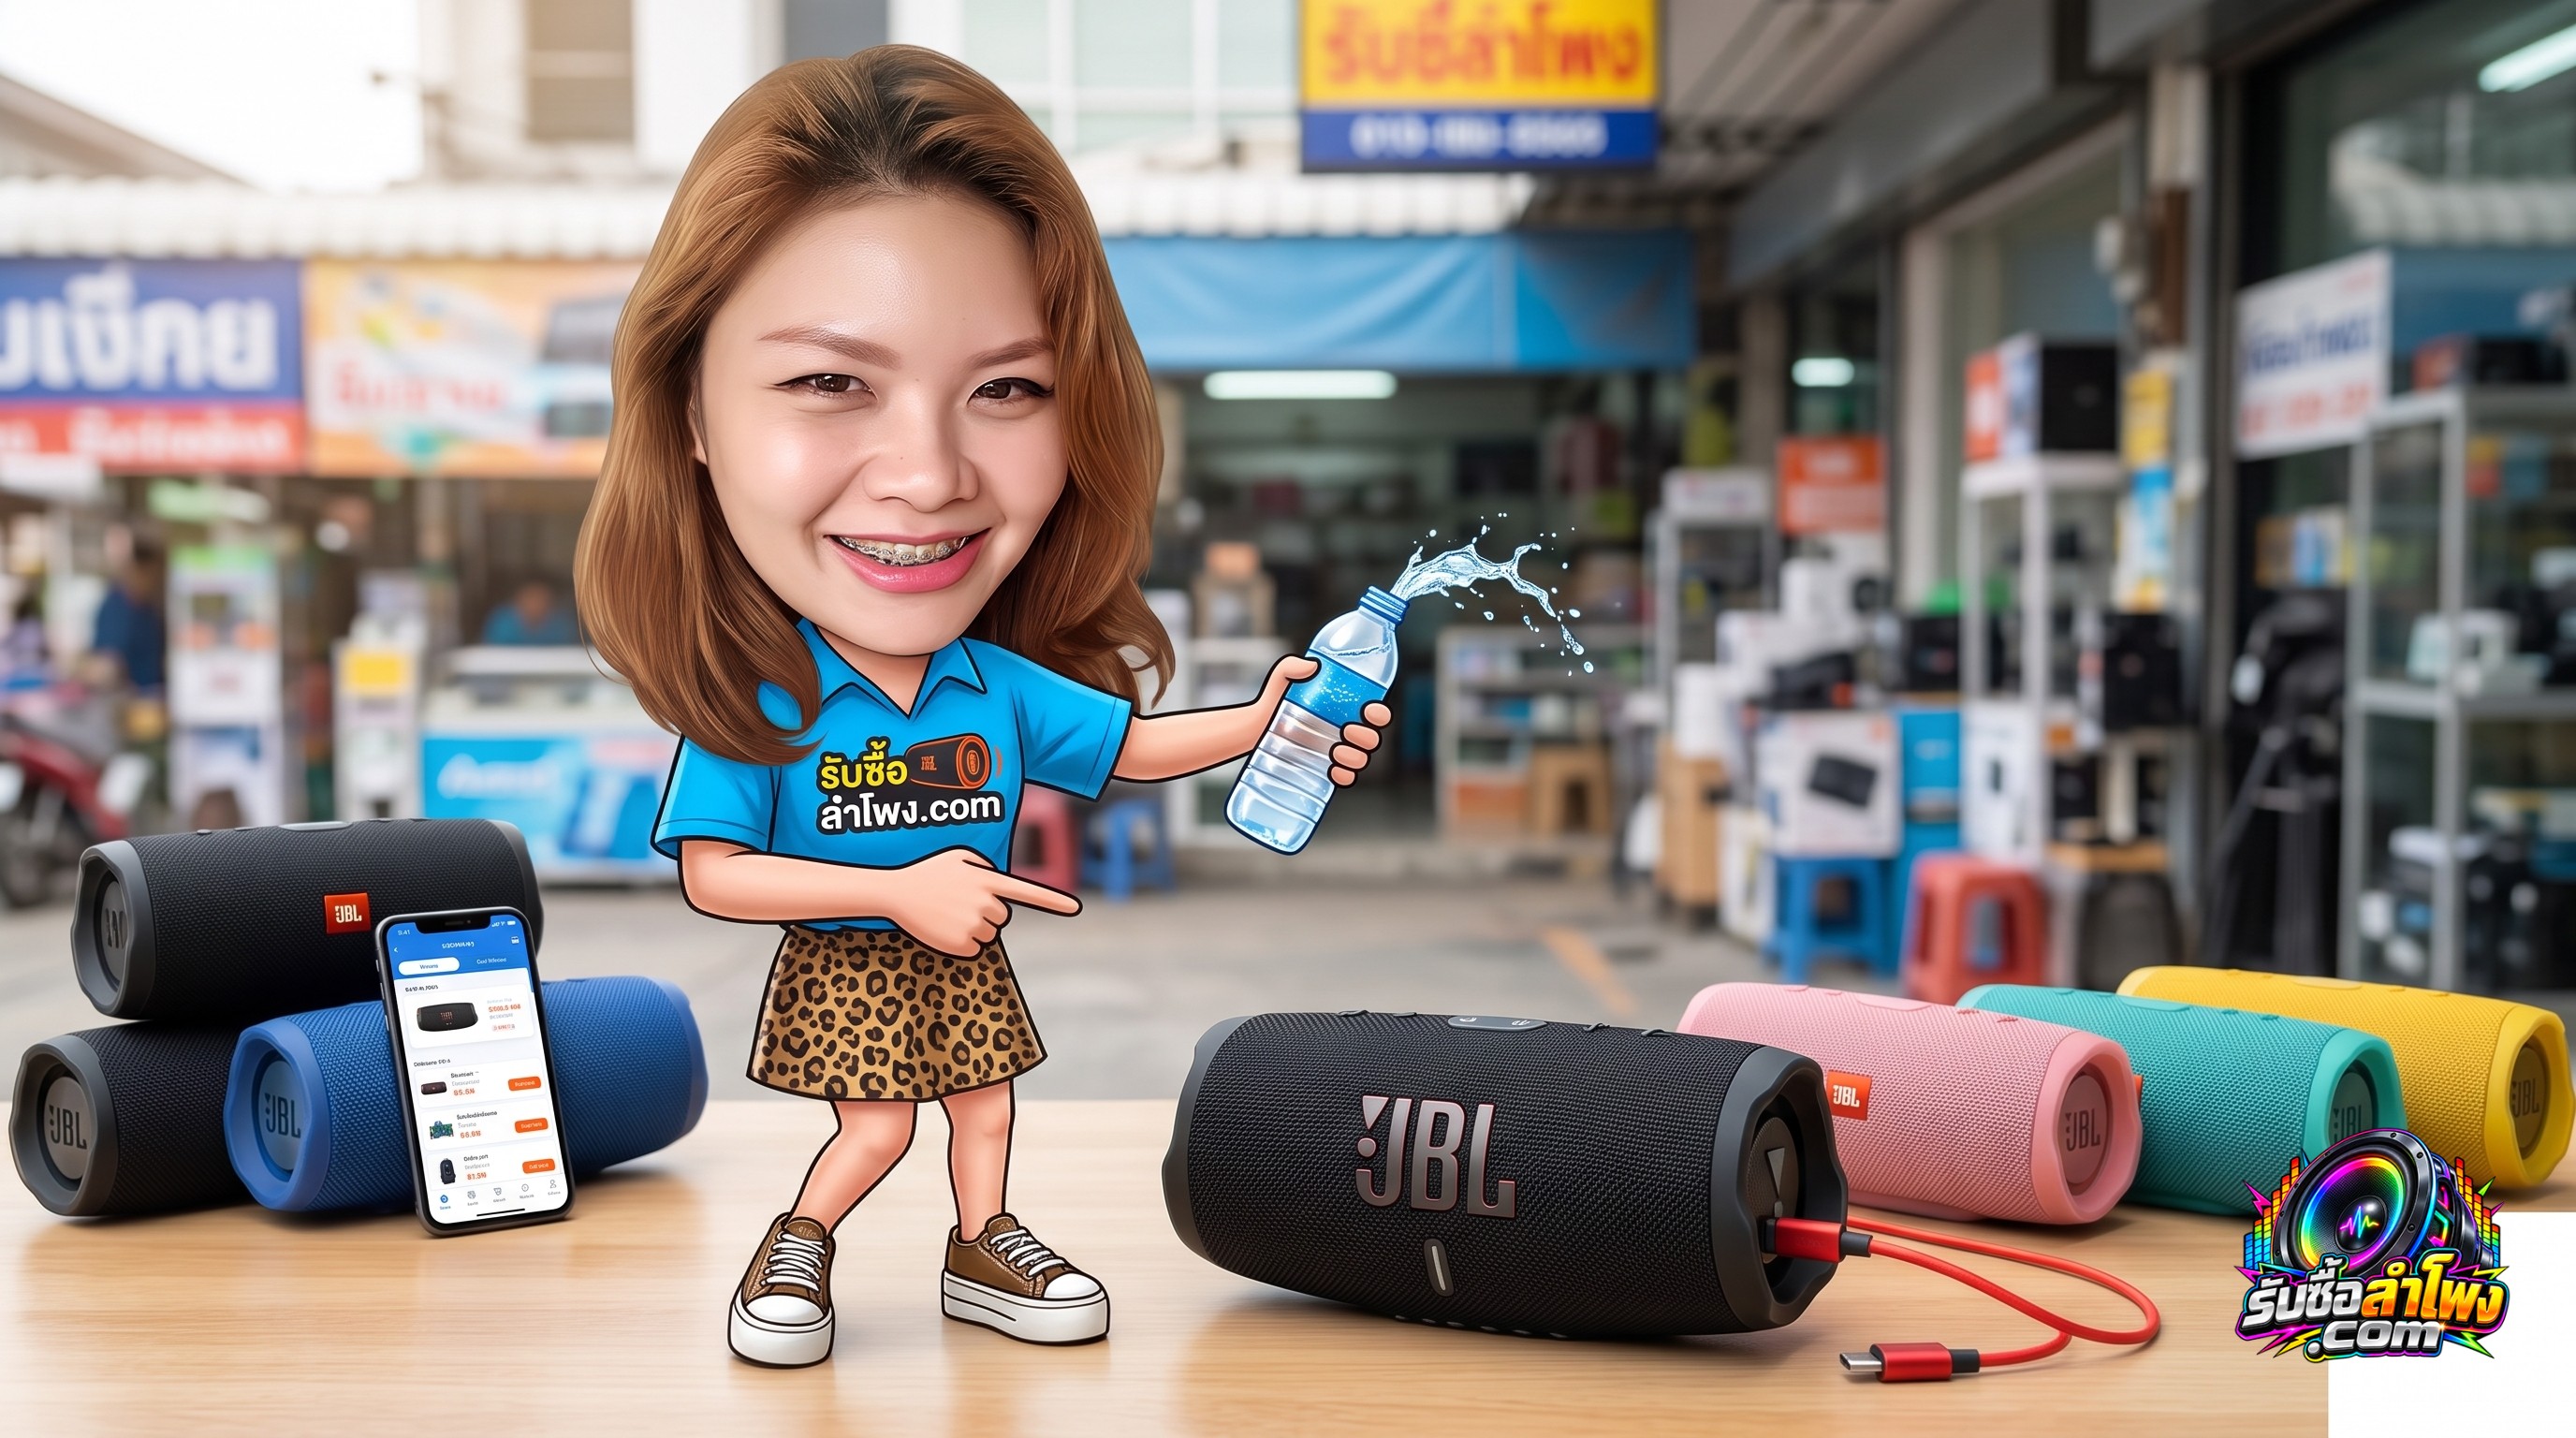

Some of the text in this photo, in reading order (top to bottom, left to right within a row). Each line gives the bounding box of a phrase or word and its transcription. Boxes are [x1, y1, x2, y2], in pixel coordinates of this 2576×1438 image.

[821, 741, 908, 789] รับซื้อ
[821, 792, 1001, 829] ลำโพง.com
[334, 904, 362, 923] JBL
[264, 1093, 301, 1138] JBL
[1834, 1084, 1860, 1108] JBL
[49, 1104, 87, 1151] JBL
[2065, 1108, 2100, 1152] JBL
[1355, 1094, 1515, 1218] JBL
